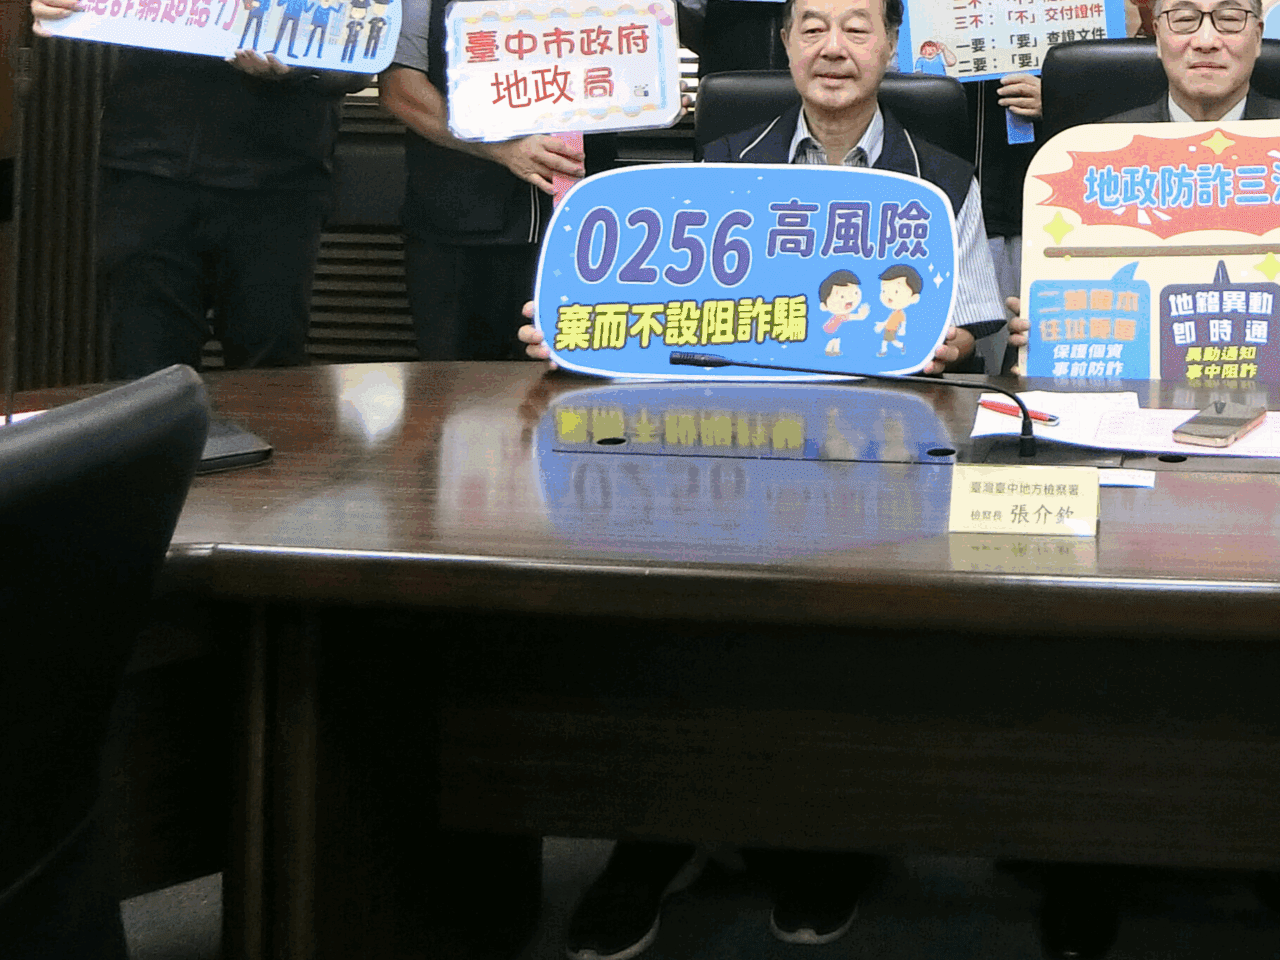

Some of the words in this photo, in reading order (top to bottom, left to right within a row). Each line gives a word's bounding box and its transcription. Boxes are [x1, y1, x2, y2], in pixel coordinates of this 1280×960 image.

[465, 22, 649, 64] 臺中市政府
[490, 64, 615, 108] 地政局
[575, 204, 754, 288] 0256
[765, 198, 932, 261] 高風險
[554, 293, 809, 352] 棄而不設阻詐騙
[1168, 290, 1274, 317] 地籍異動
[1172, 318, 1269, 345] 即時通
